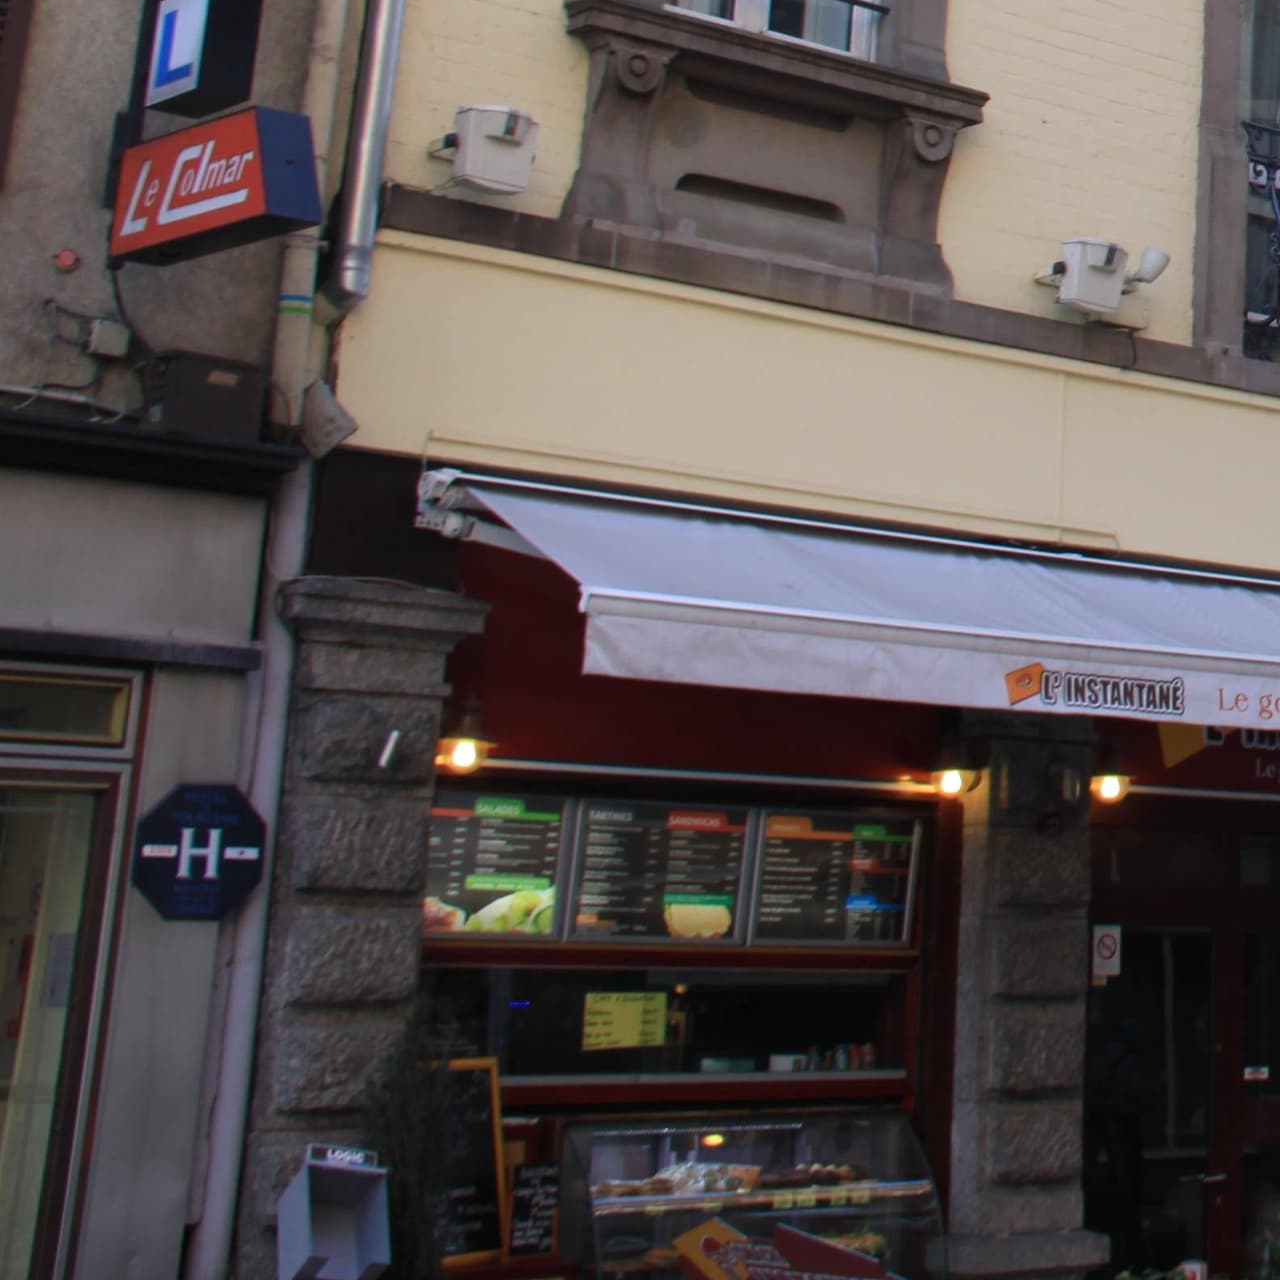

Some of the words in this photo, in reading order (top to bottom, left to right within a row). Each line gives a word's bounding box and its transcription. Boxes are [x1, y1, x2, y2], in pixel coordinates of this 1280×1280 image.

[120, 160, 160, 237] Le
[157, 140, 254, 225] Colmar
[1217, 687, 1248, 712] Le
[1256, 758, 1276, 779] Le
[176, 827, 222, 879] H
